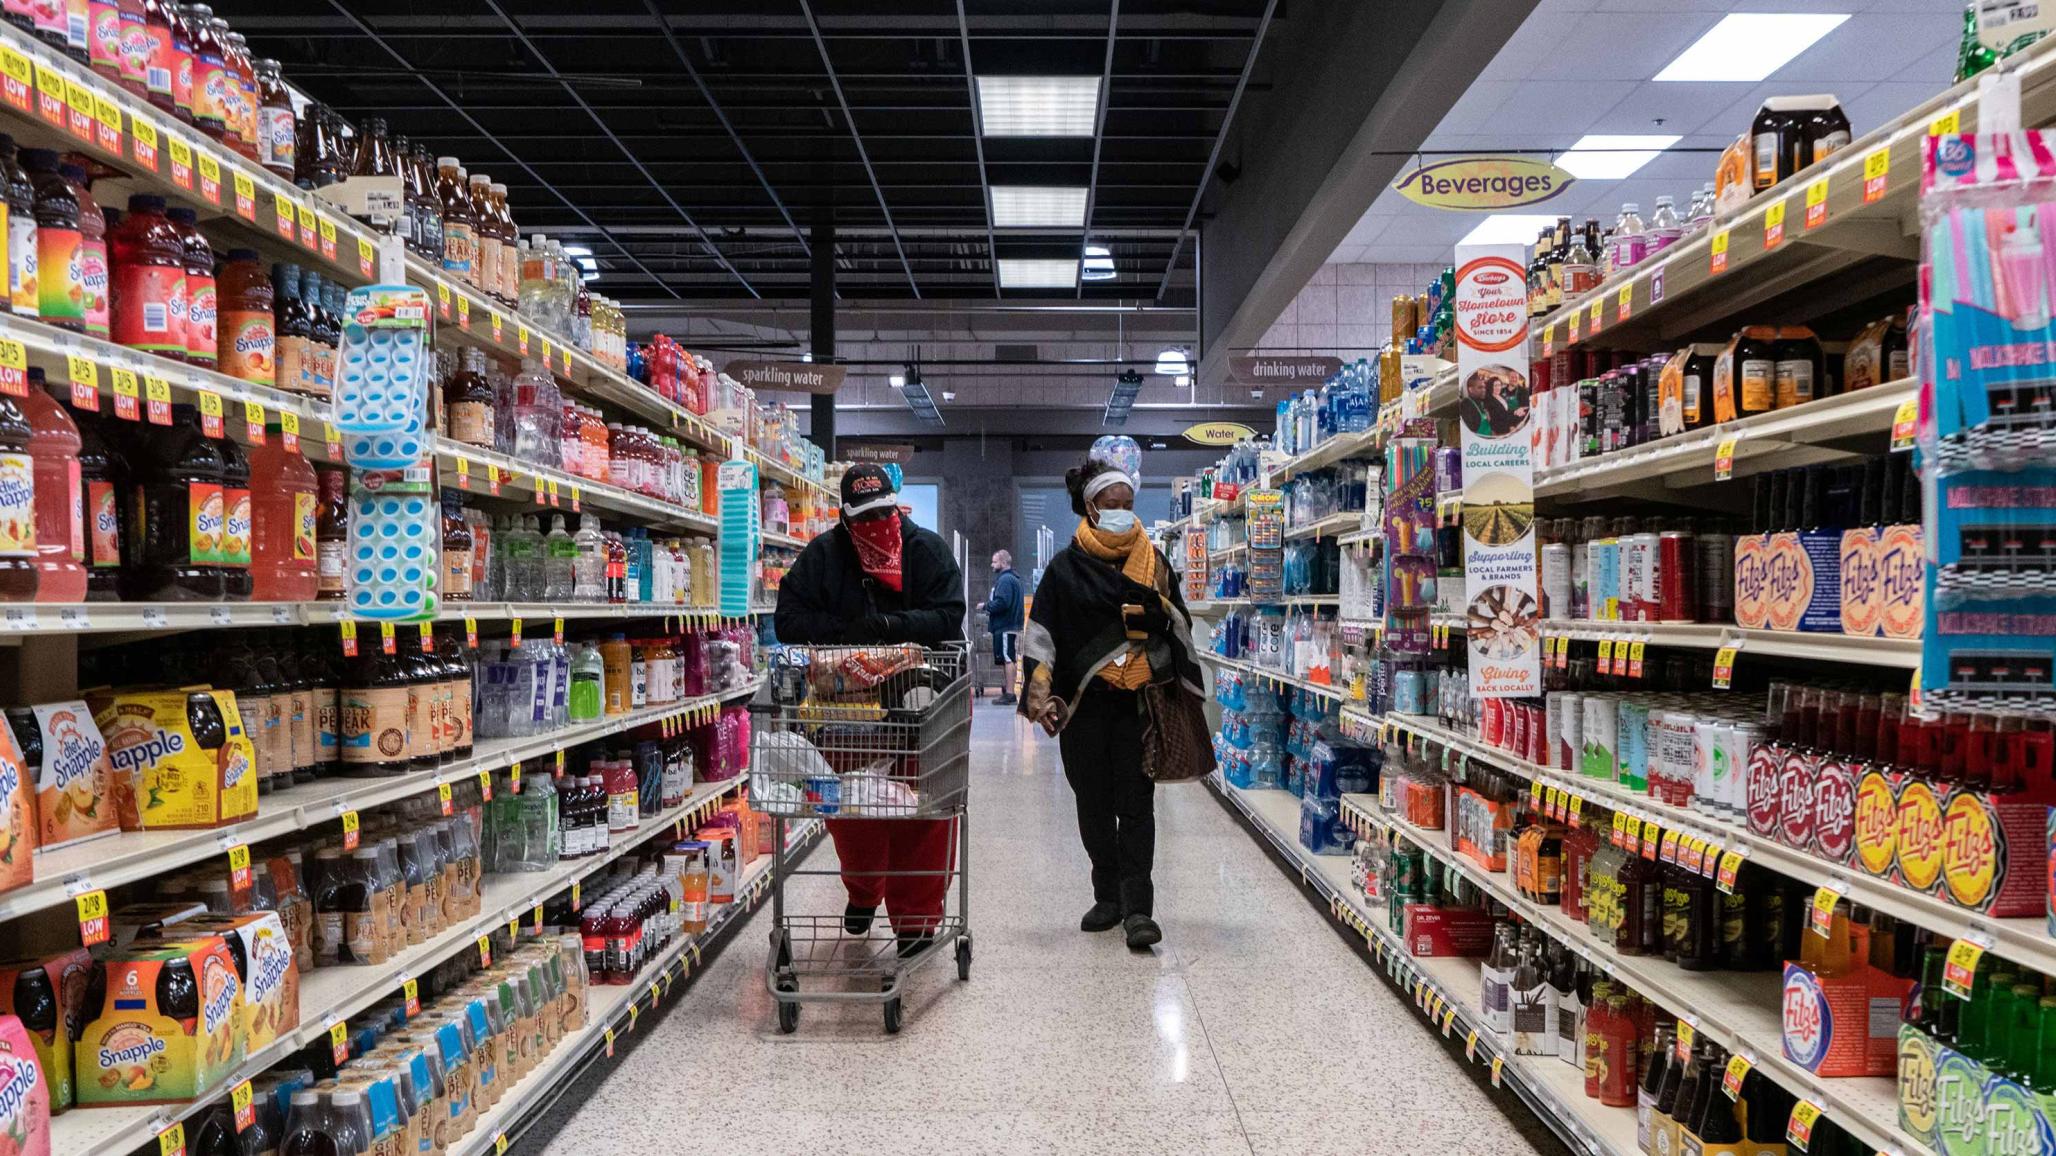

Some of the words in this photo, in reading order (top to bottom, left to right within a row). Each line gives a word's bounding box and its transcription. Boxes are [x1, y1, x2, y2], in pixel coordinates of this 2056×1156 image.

[4, 75, 26, 97] LOW
[40, 92, 61, 112] LOW
[70, 108, 90, 128] LOW
[98, 122, 118, 143] LOW
[136, 139, 153, 160] LOW
[172, 161, 188, 178] LOW
[202, 176, 217, 193] LOW
[1421, 173, 1552, 197] Beverages
[238, 194, 252, 209] LOW
[1478, 287, 1503, 298] Your
[1458, 298, 1525, 312] Hometown
[1471, 311, 1517, 330] Store
[0, 366, 23, 384] LOW
[743, 366, 791, 385] sparkling
[793, 371, 824, 387] water
[1253, 361, 1295, 379] drinking
[1297, 363, 1327, 376] water
[74, 384, 94, 399] LOW
[117, 394, 134, 409] LOW
[151, 401, 168, 413] LOW
[204, 416, 219, 428] LOW
[249, 424, 262, 435] LOW
[284, 433, 297, 444] LOW
[1205, 429, 1235, 440] Water
[846, 447, 878, 460] sparkling
[879, 449, 899, 460] water
[1465, 442, 1529, 458] Building
[1465, 460, 1492, 468] LOCAL
[1493, 459, 1530, 467] CAREERS
[688, 472, 696, 500] core
[1417, 497, 1433, 508] 75
[1468, 550, 1533, 564] Supporting
[1468, 566, 1494, 574] LOCAL
[1496, 565, 1533, 573] FARMERS
[1481, 573, 1487, 581] &
[1736, 553, 1768, 602] Fitz's
[1768, 552, 1800, 602] Fitz's
[1842, 550, 1878, 605] Fitz's
[1881, 548, 1924, 606] Fitz's
[1270, 624, 1280, 653] core
[1480, 667, 1530, 683] Giving
[1476, 684, 1497, 692] BACK
[1499, 684, 1535, 692] LOCALLY
[64, 739, 81, 758] diet
[53, 737, 100, 788] Snapple
[1748, 761, 1779, 812] Fitz's
[1779, 770, 1814, 823] Fitz's
[1814, 779, 1853, 835] Fitz's
[1856, 790, 1896, 847] Fitz's
[1898, 800, 1944, 862] Fitz's
[1944, 812, 1996, 877] Fitz's
[233, 869, 247, 883] LOW
[82, 918, 104, 936] LOW
[262, 953, 275, 974] diet
[126, 970, 138, 986] 6
[255, 948, 290, 1003] Snapple
[204, 975, 237, 1033] Snapple
[1785, 986, 1820, 1042] Fitz's
[100, 1037, 165, 1067] Snapple
[236, 1105, 251, 1122] LOW
[1937, 1074, 1985, 1144] Fitz's
